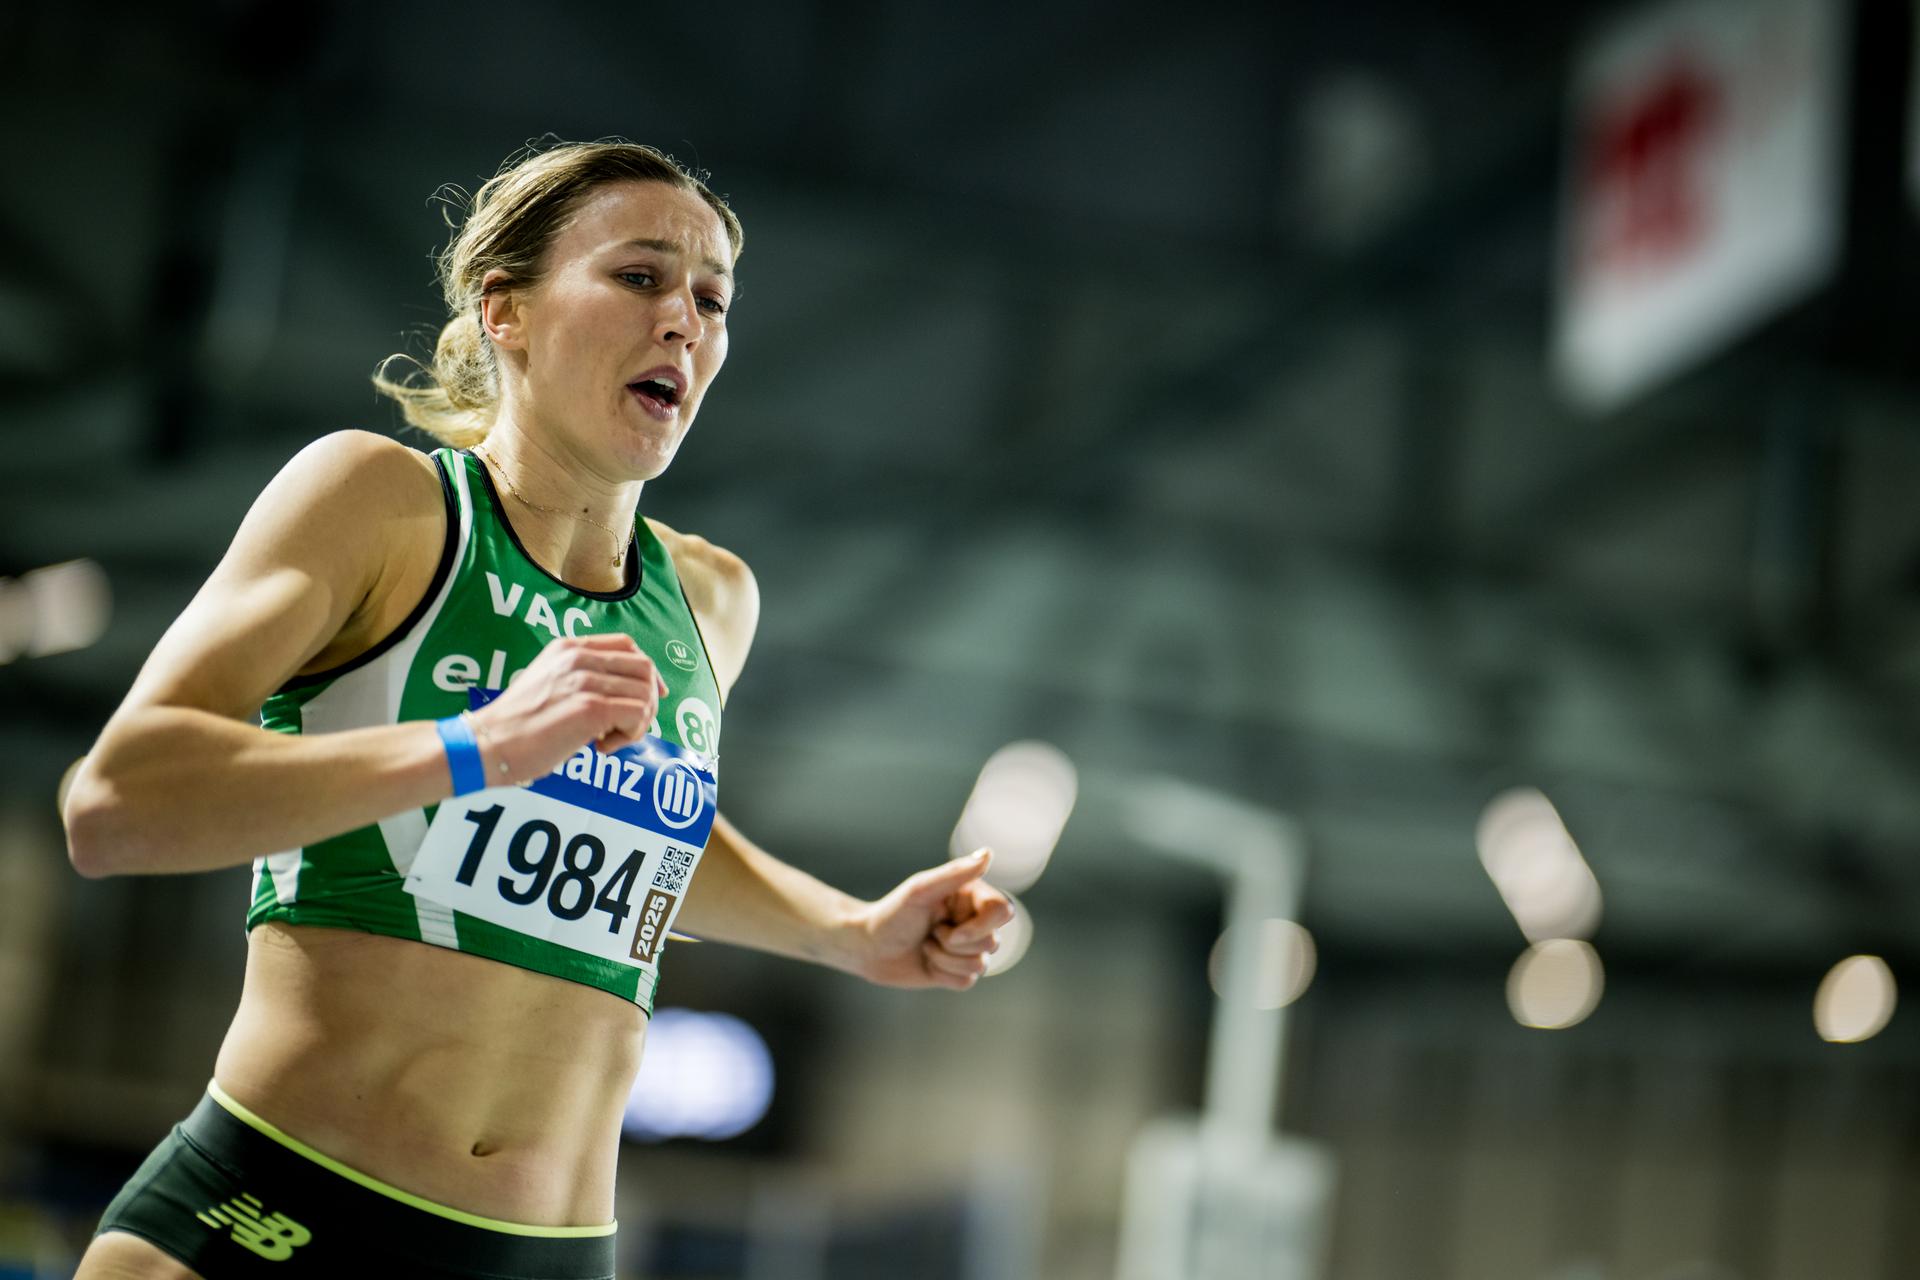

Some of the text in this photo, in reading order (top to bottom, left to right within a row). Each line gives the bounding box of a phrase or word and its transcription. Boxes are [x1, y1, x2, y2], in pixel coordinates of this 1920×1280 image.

[485, 571, 593, 639] VAC
[432, 649, 528, 692] el
[455, 804, 646, 935] 1984
[636, 895, 667, 957] 2025
